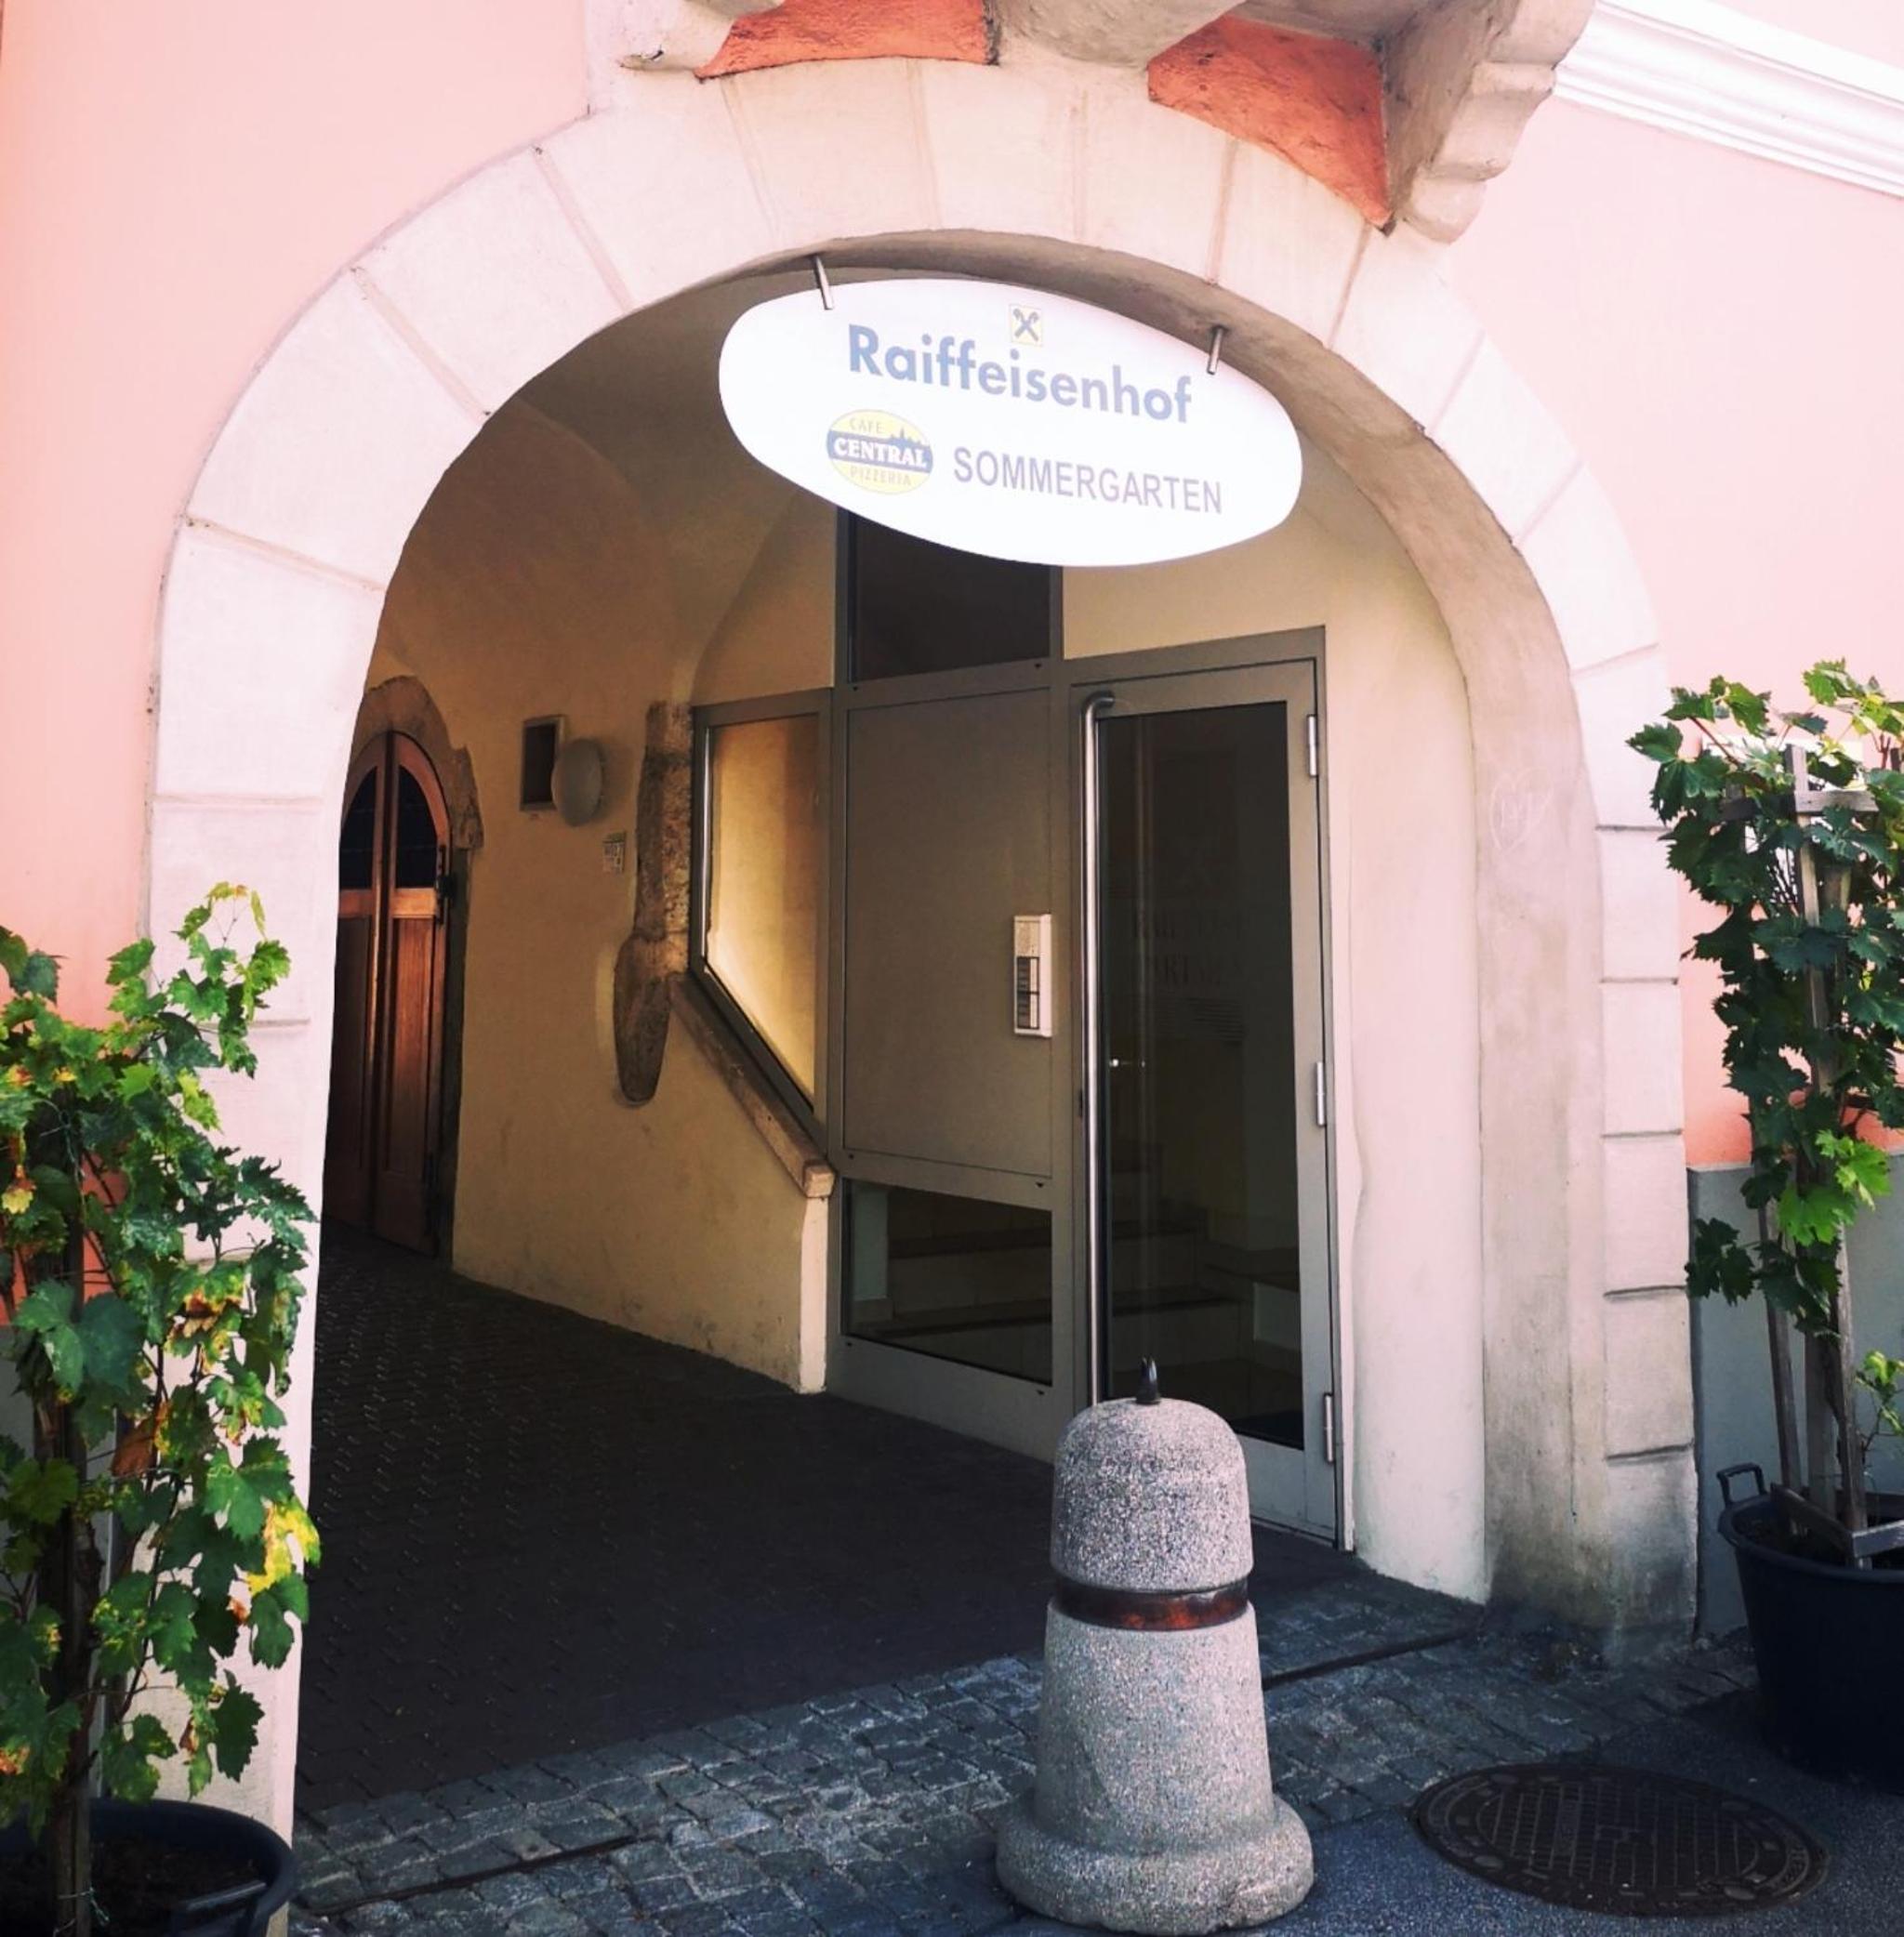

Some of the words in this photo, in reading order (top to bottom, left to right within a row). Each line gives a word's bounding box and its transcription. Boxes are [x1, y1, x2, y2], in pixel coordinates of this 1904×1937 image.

[848, 323, 1192, 424] Raiffeisenhof
[833, 438, 928, 469] CENTRAL
[850, 465, 912, 486] PIZZERIA
[953, 446, 1222, 514] SOMMERGARTEN
